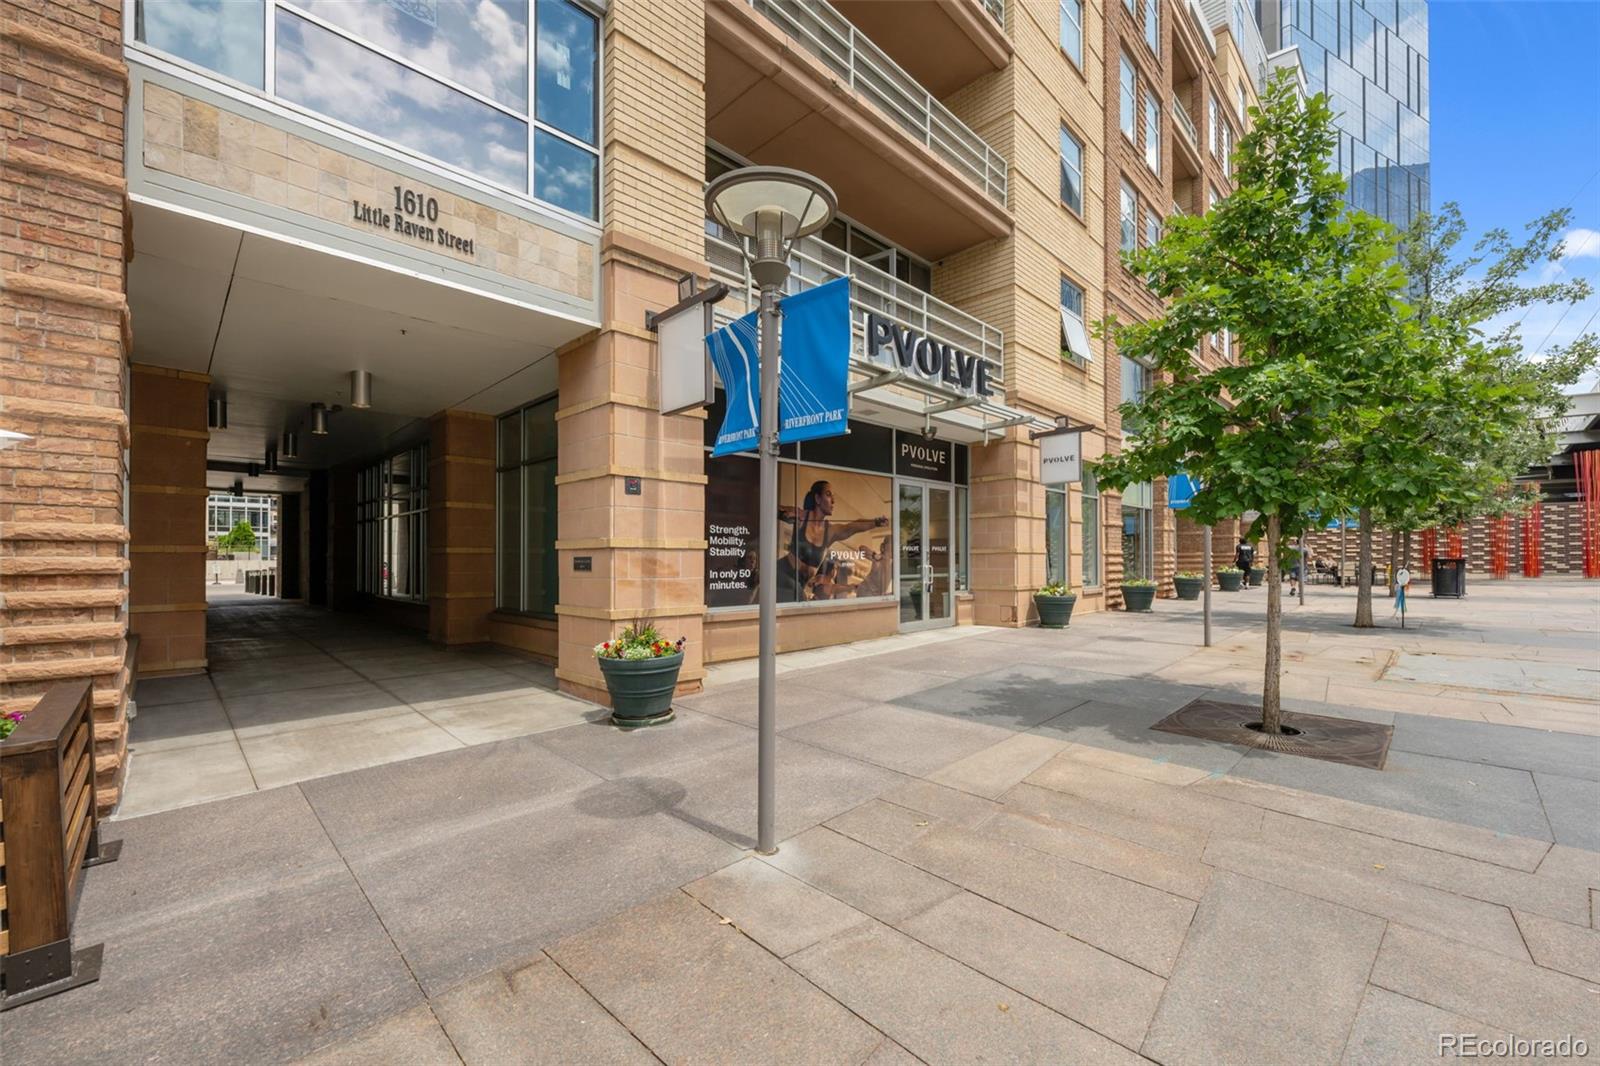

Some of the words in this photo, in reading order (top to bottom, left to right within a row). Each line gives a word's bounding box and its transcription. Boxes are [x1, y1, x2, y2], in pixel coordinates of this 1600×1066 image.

[394, 186, 439, 222] 1610
[353, 200, 391, 229] Little
[394, 213, 434, 242] Raven
[437, 227, 475, 255] Street
[866, 313, 995, 397] PVOLVE
[784, 412, 824, 430] RIVERFRONT
[825, 409, 843, 422] PARK
[901, 443, 946, 464] PVOLVE
[1043, 454, 1076, 465] PVOLVE
[709, 524, 750, 536] Strength.
[709, 536, 746, 547] Mobility.
[709, 547, 746, 558] Stability
[830, 550, 866, 560] PVOLVE
[709, 570, 718, 578] In
[719, 570, 738, 580] only
[739, 569, 751, 578] 50
[709, 581, 748, 590] minutes.
